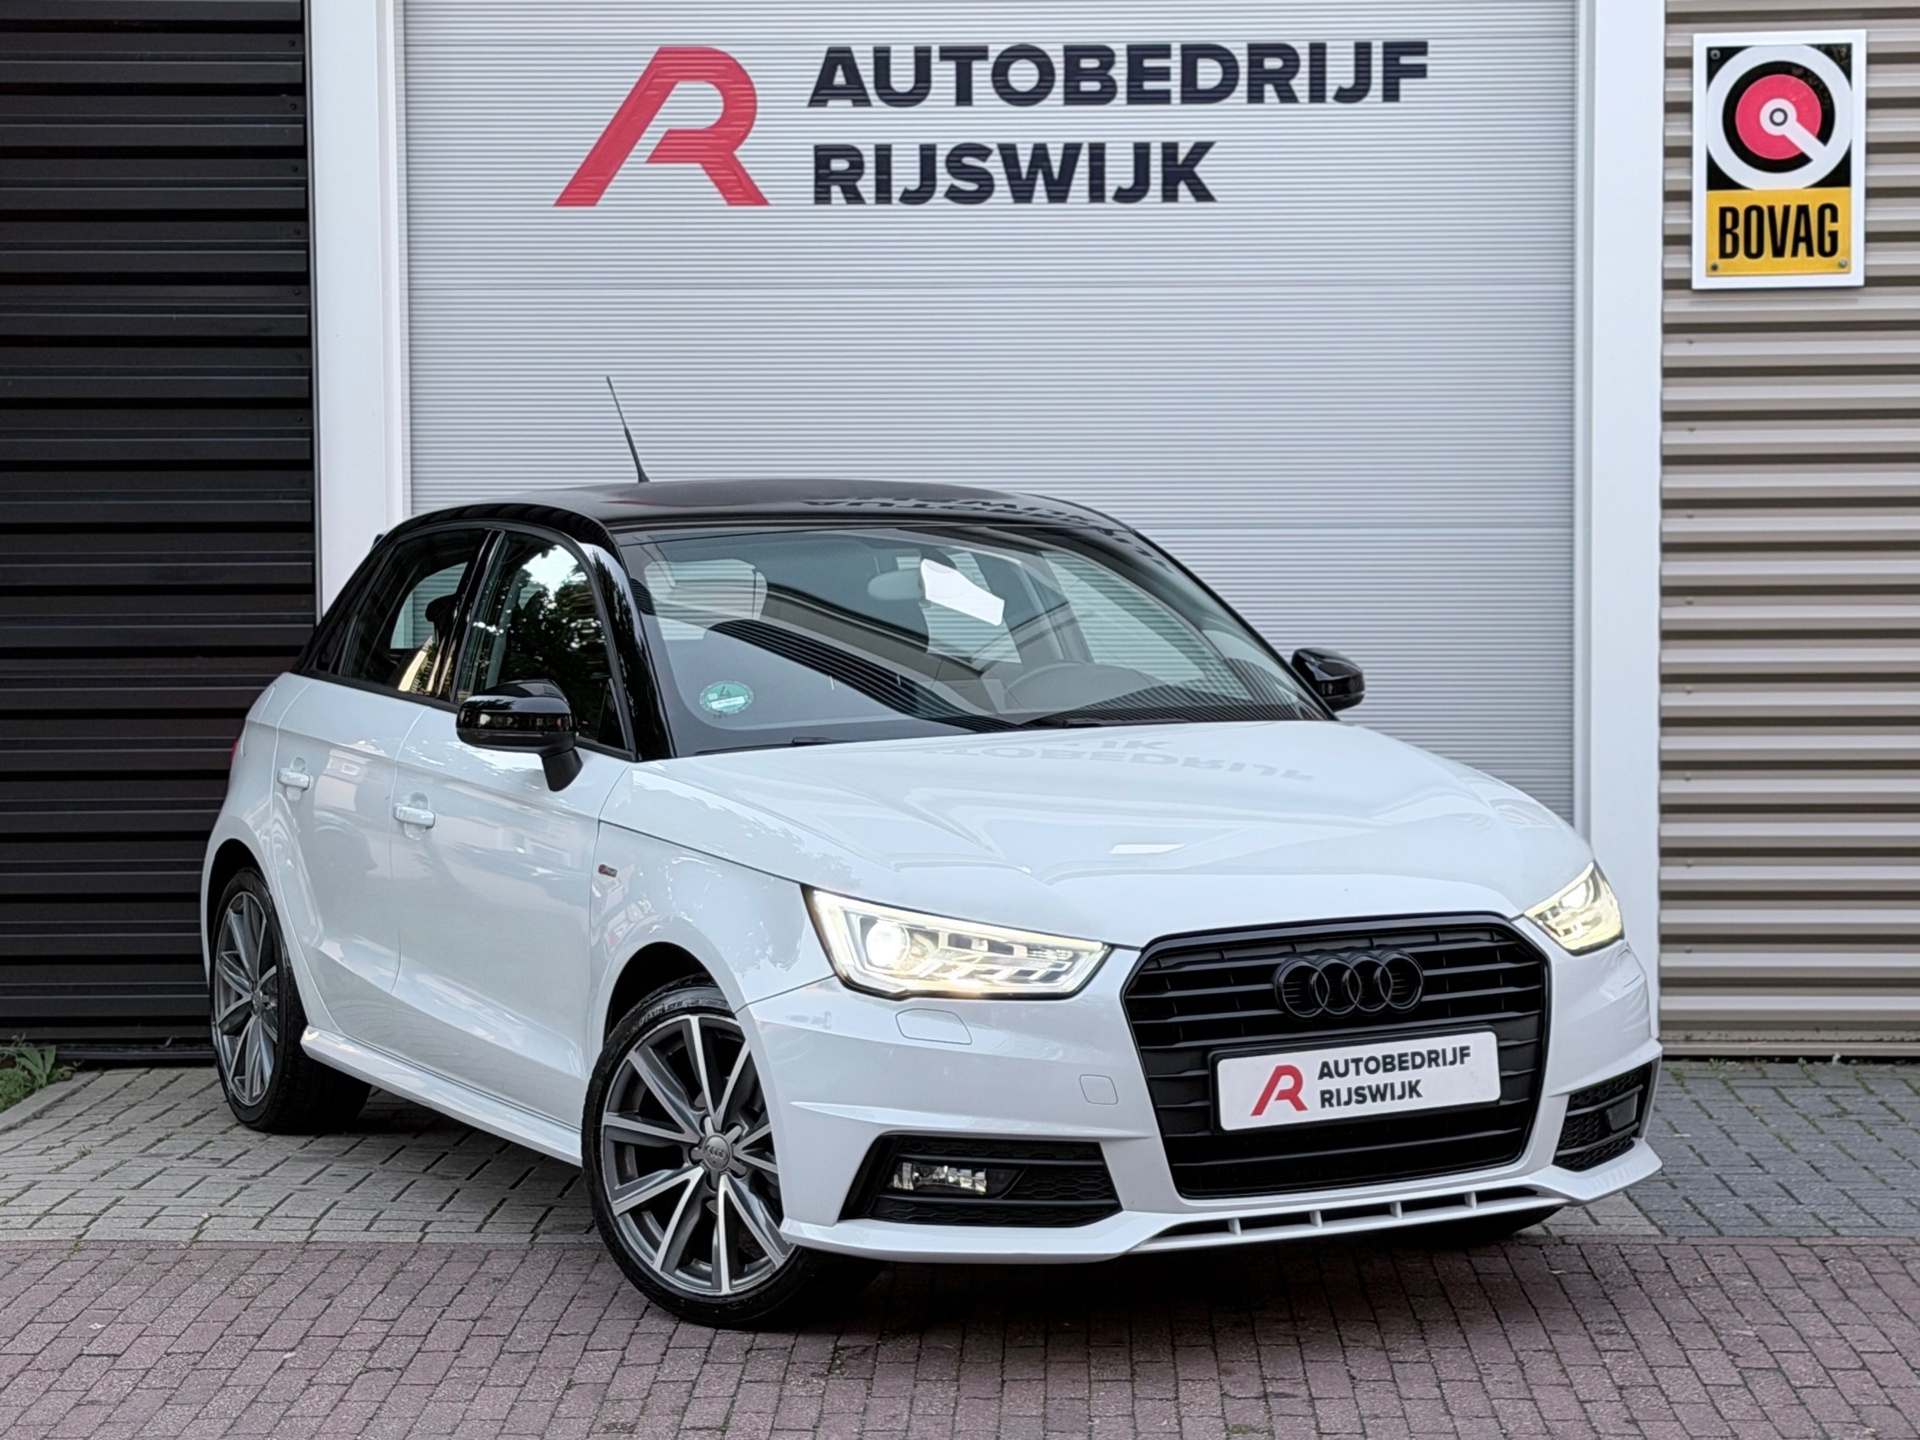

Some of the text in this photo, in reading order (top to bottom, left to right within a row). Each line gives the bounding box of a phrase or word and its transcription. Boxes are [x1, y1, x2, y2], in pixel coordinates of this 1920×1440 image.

[808, 41, 1428, 108] AUTOBEDRIJF
[813, 141, 1216, 206] RIJSWIJK
[1718, 203, 1839, 259] BOVAG
[1317, 1045, 1471, 1080] AUTOBEDRIJF
[1319, 1079, 1423, 1109] RIJSWIJK
